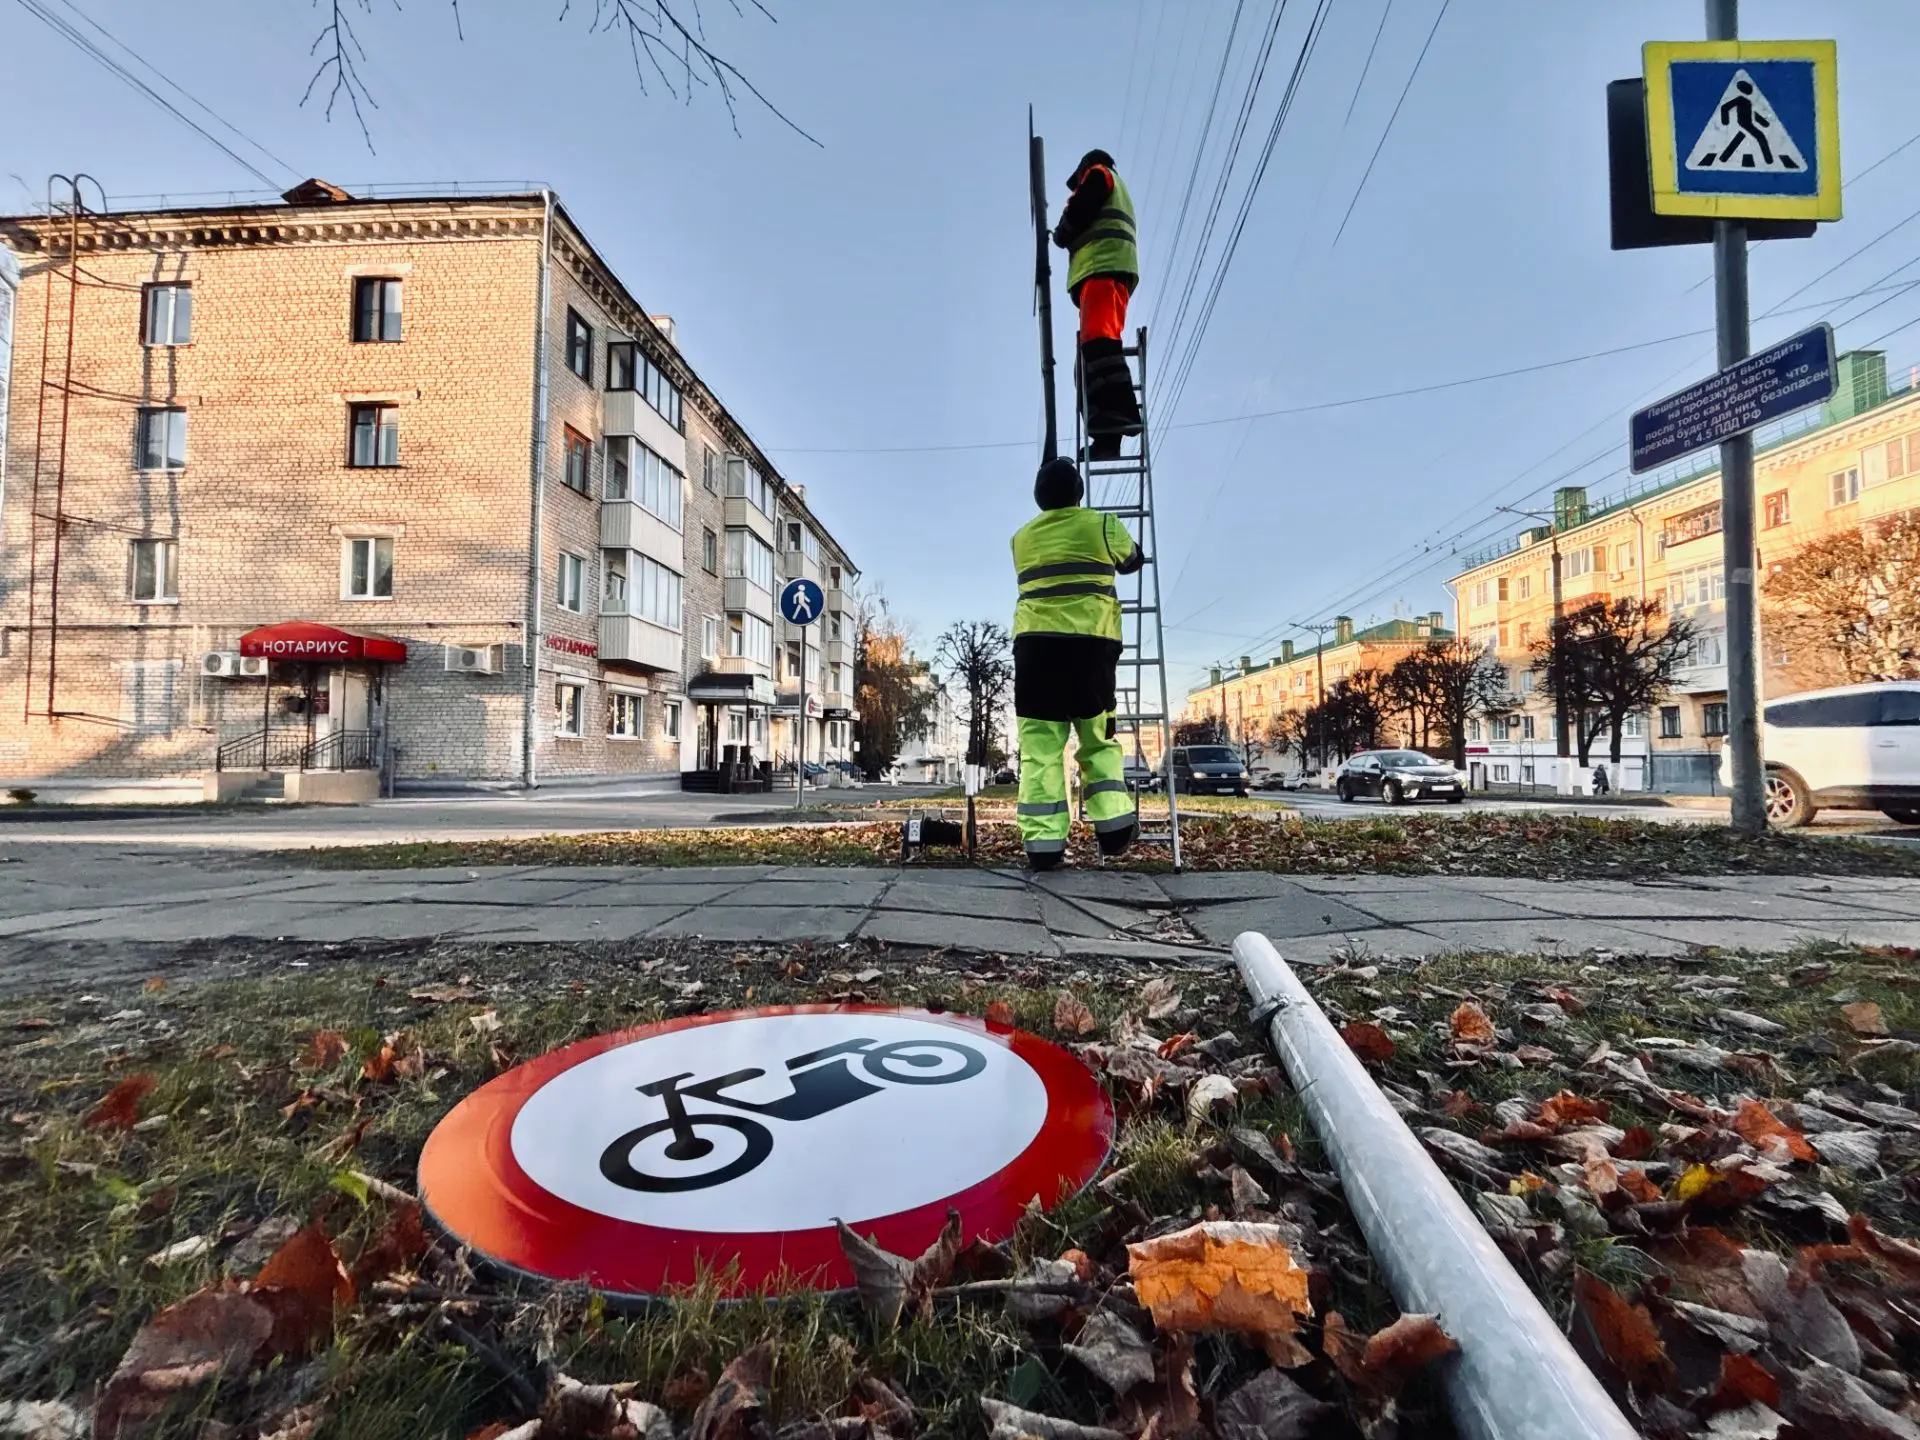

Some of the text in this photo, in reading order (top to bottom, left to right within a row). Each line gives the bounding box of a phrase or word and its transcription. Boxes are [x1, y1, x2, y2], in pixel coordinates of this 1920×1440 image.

[1645, 424, 1675, 441] после
[1678, 412, 1701, 427] того
[1703, 403, 1721, 416] как
[1785, 364, 1809, 378] что
[1648, 342, 1804, 418] Пешеходы могут выходить
[1668, 367, 1776, 420] на проезжую часть
[1634, 369, 1829, 456] переход будет для них безопасен
[1715, 417, 1740, 435] ПДД
[1742, 408, 1762, 424] РФ
[262, 640, 349, 654] НОТАРИУС
[546, 634, 598, 659] НОТАРИУС
